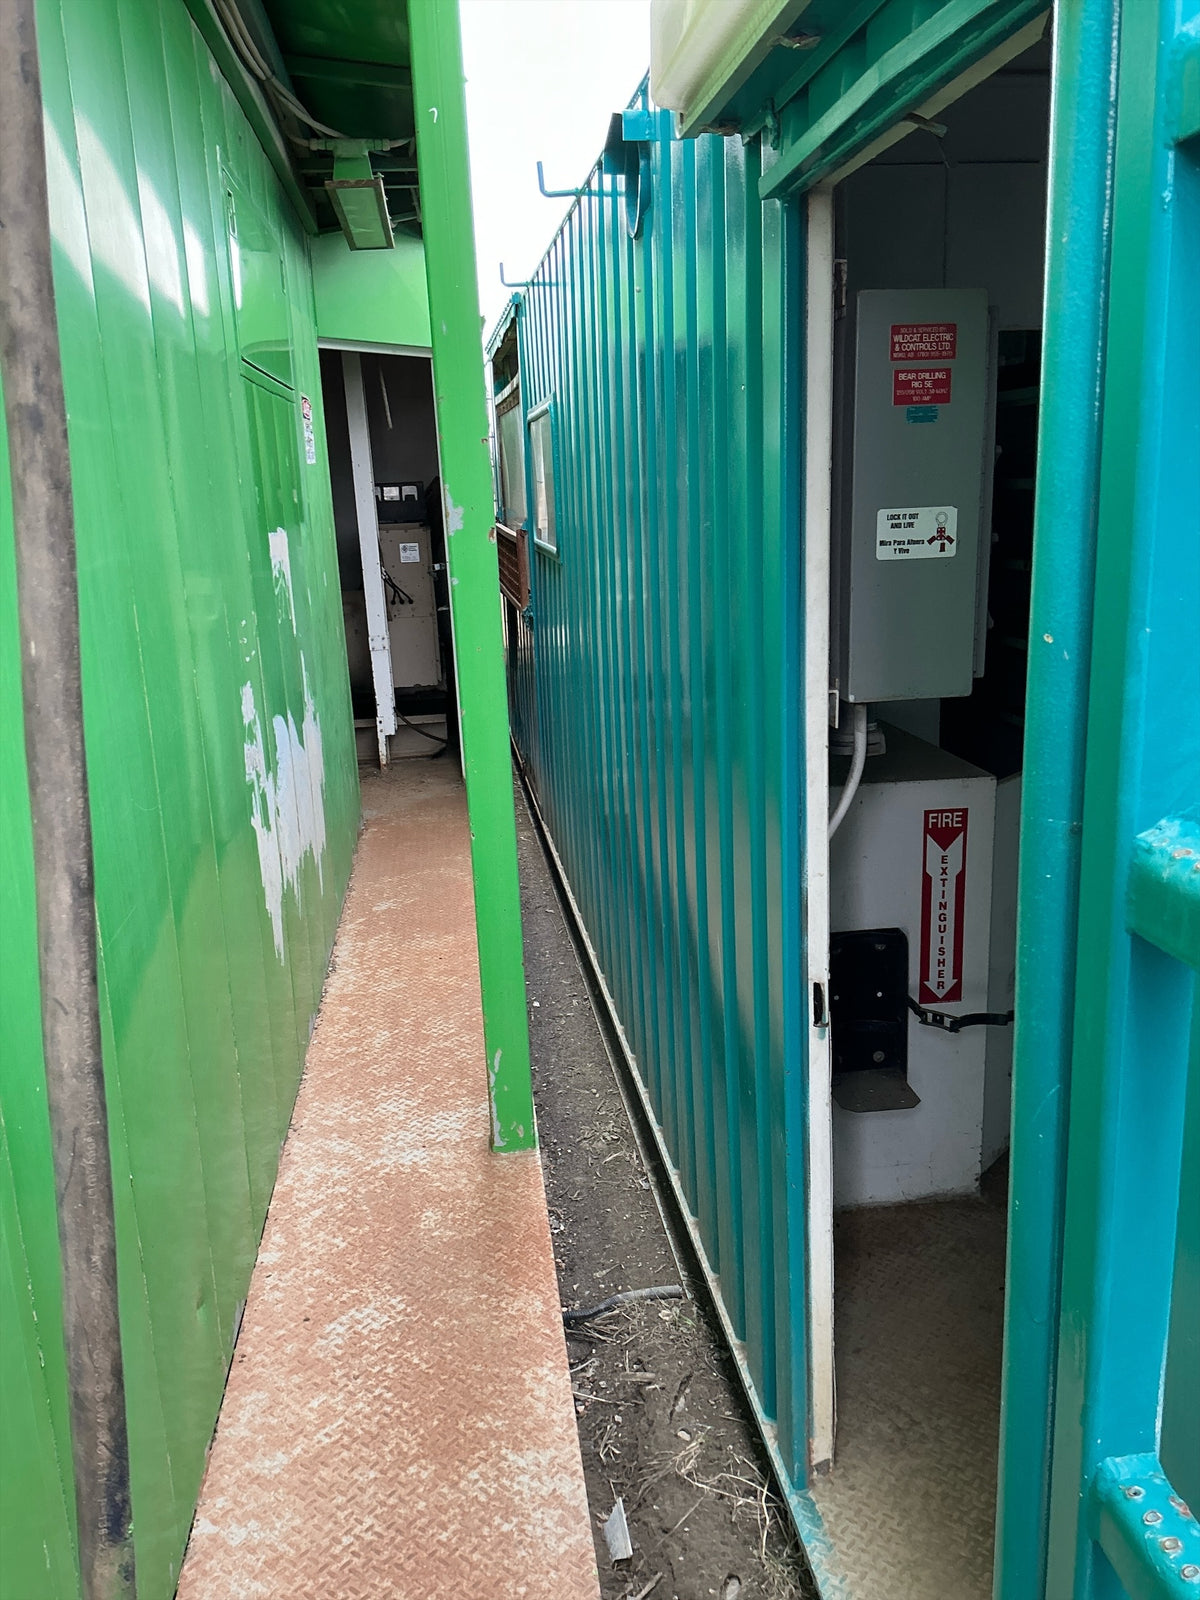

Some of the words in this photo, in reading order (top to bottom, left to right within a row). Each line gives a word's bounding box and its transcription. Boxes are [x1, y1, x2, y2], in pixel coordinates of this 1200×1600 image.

[893, 334, 921, 342] WILDCAT
[922, 333, 954, 342] ELECTRIC
[894, 343, 900, 351] &
[901, 342, 937, 351] CONTROLS
[938, 342, 951, 350] LTD.
[886, 513, 901, 521] LOCK
[928, 811, 963, 829] FIRE
[936, 855, 949, 990] EXTINGUISHER
